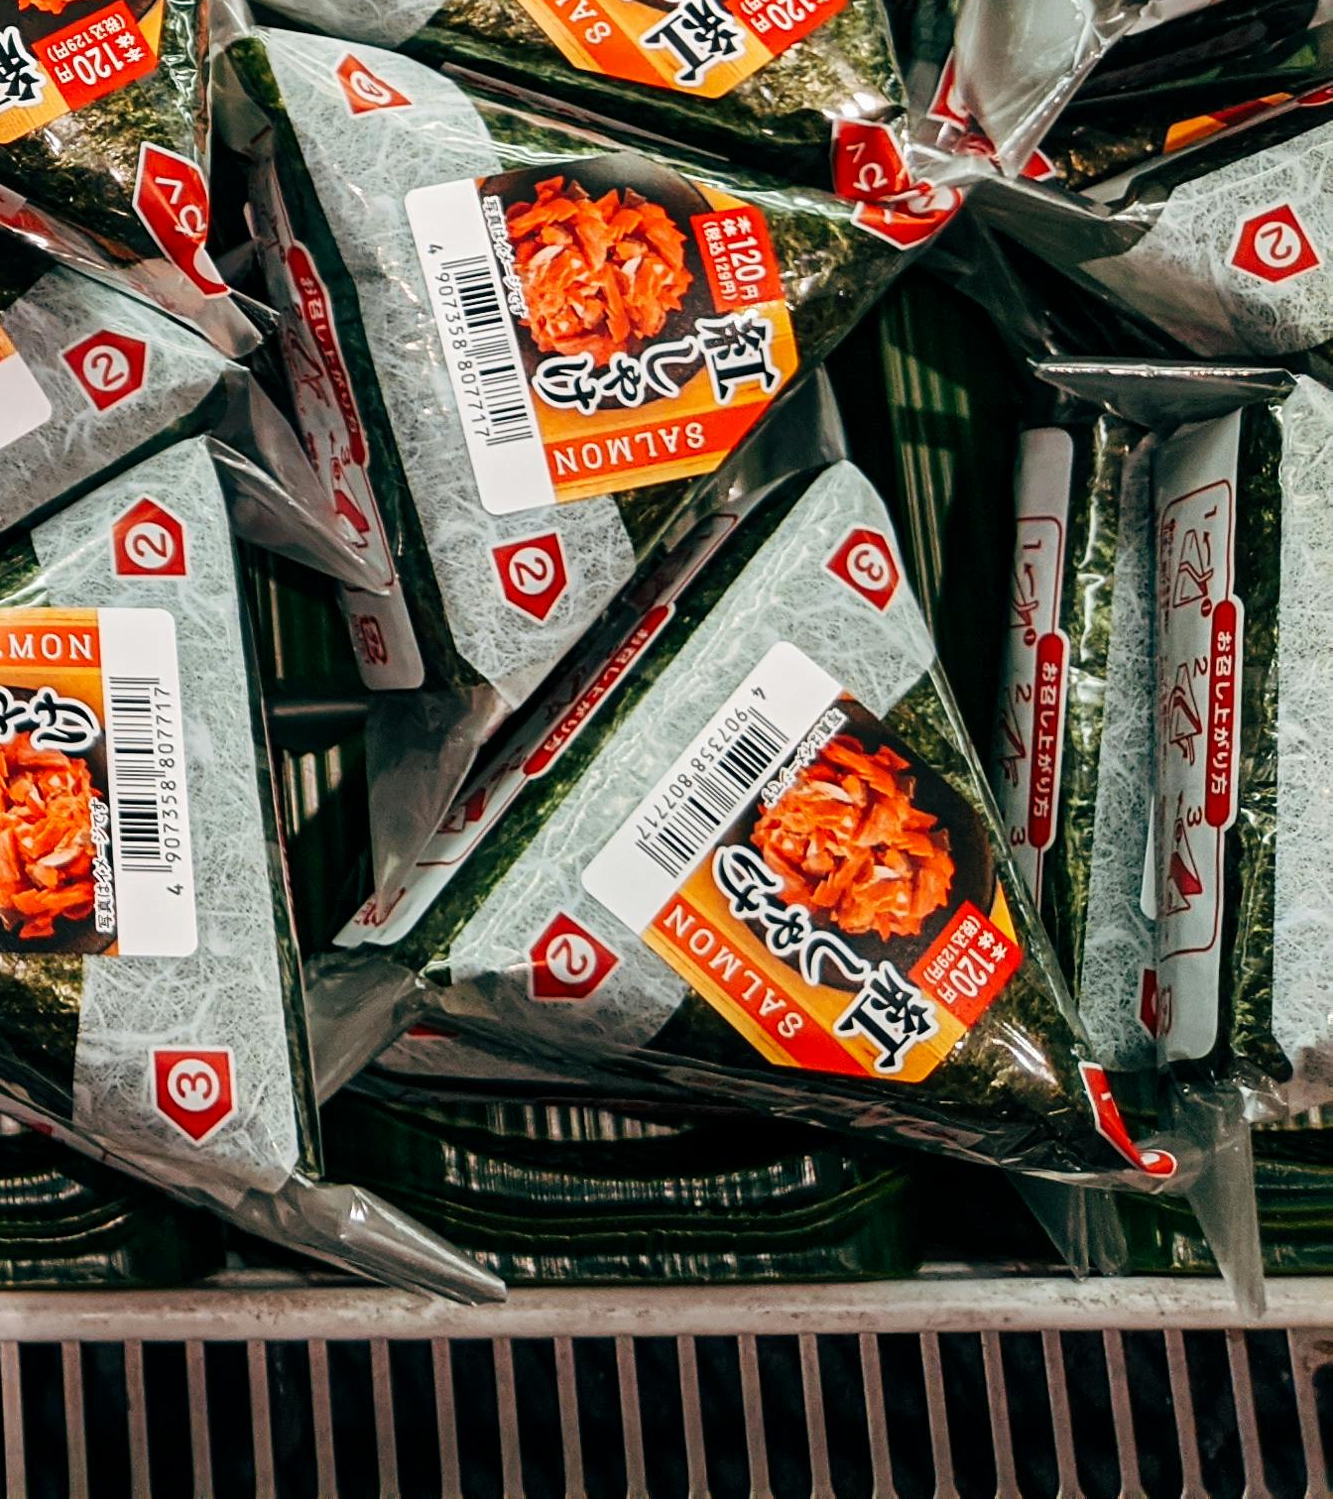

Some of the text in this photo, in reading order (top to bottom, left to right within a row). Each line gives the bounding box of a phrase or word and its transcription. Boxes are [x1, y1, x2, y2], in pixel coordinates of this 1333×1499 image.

[43, 10, 130, 63] (税込129円)
[701, 218, 737, 303] (税込129円)
[537, 318, 780, 414] 紅しゃけ
[551, 419, 708, 475] SALMON
[634, 682, 772, 840] 4 907358 807717
[1032, 661, 1060, 819] お召し上がり方
[1210, 629, 1234, 796] お召し上がり方
[662, 903, 810, 1038] SALMON
[710, 849, 937, 1066] 紅しゃけ
[920, 911, 984, 986] (税込129円)
